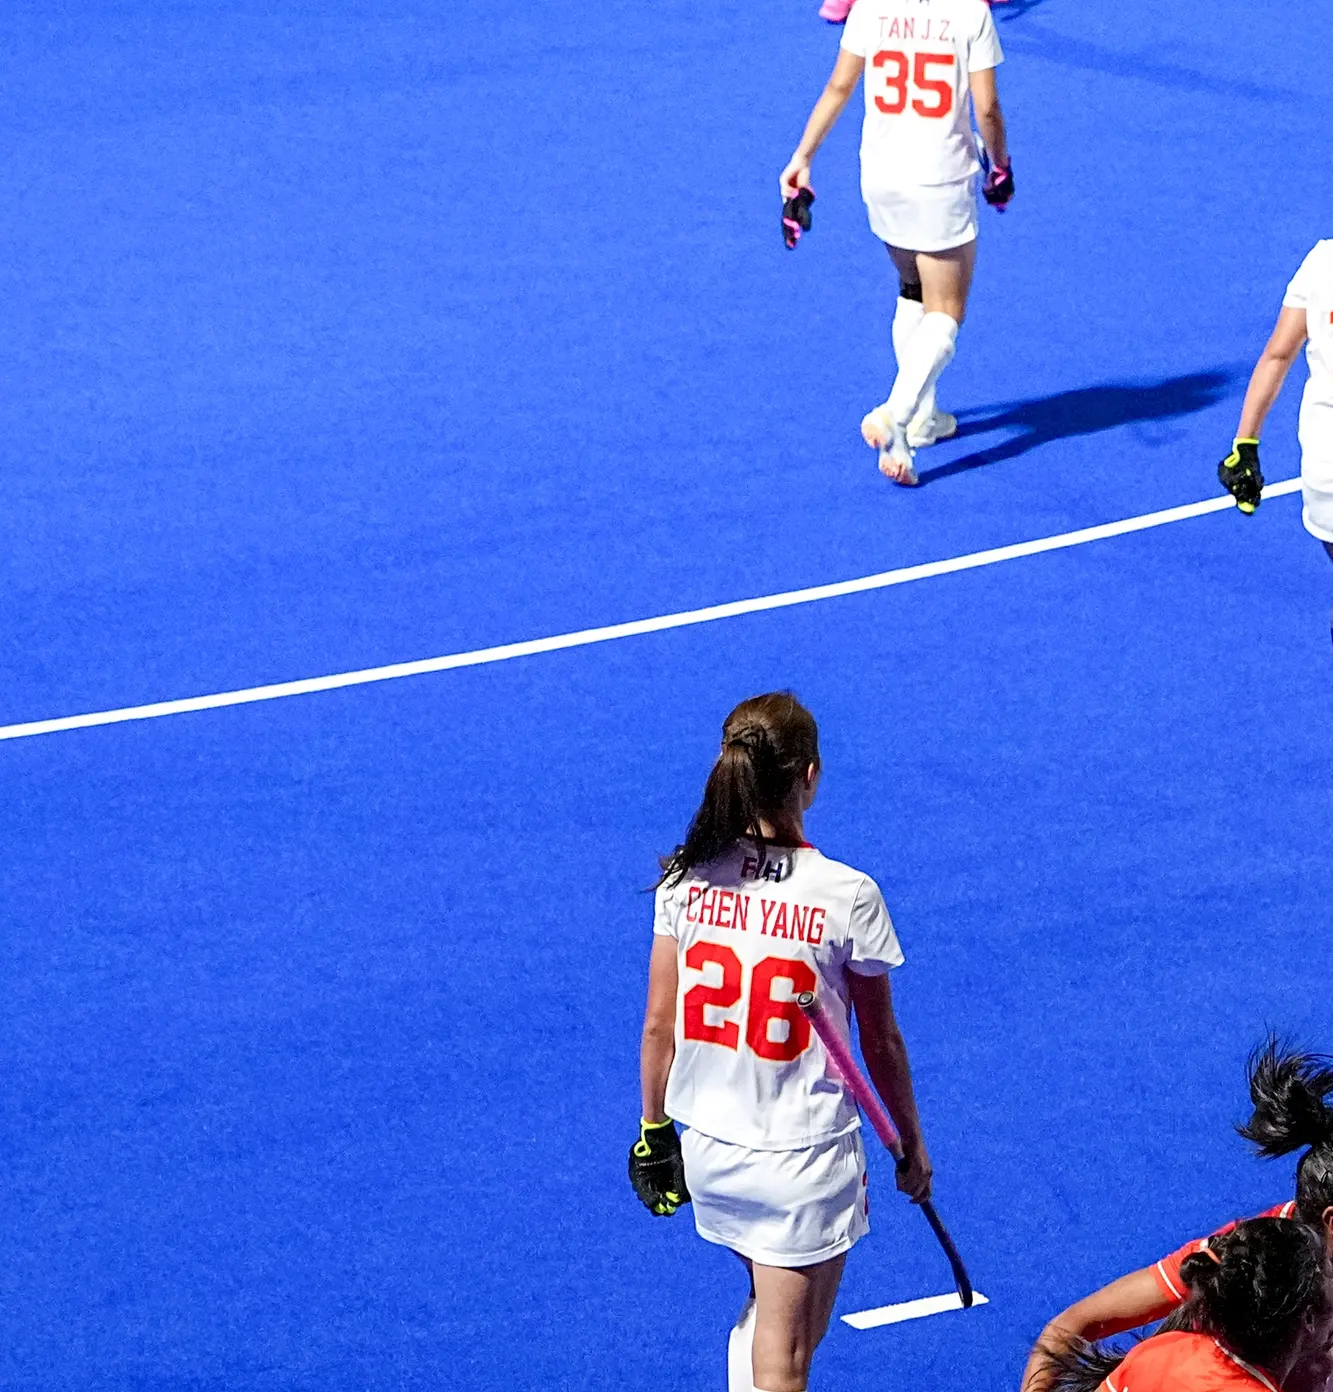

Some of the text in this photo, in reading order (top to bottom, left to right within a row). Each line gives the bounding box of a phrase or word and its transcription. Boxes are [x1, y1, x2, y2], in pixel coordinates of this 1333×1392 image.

[878, 16, 916, 40] TAN
[872, 50, 955, 119] 35
[687, 885, 825, 946] CHEN YANG
[683, 939, 817, 1063] 26
